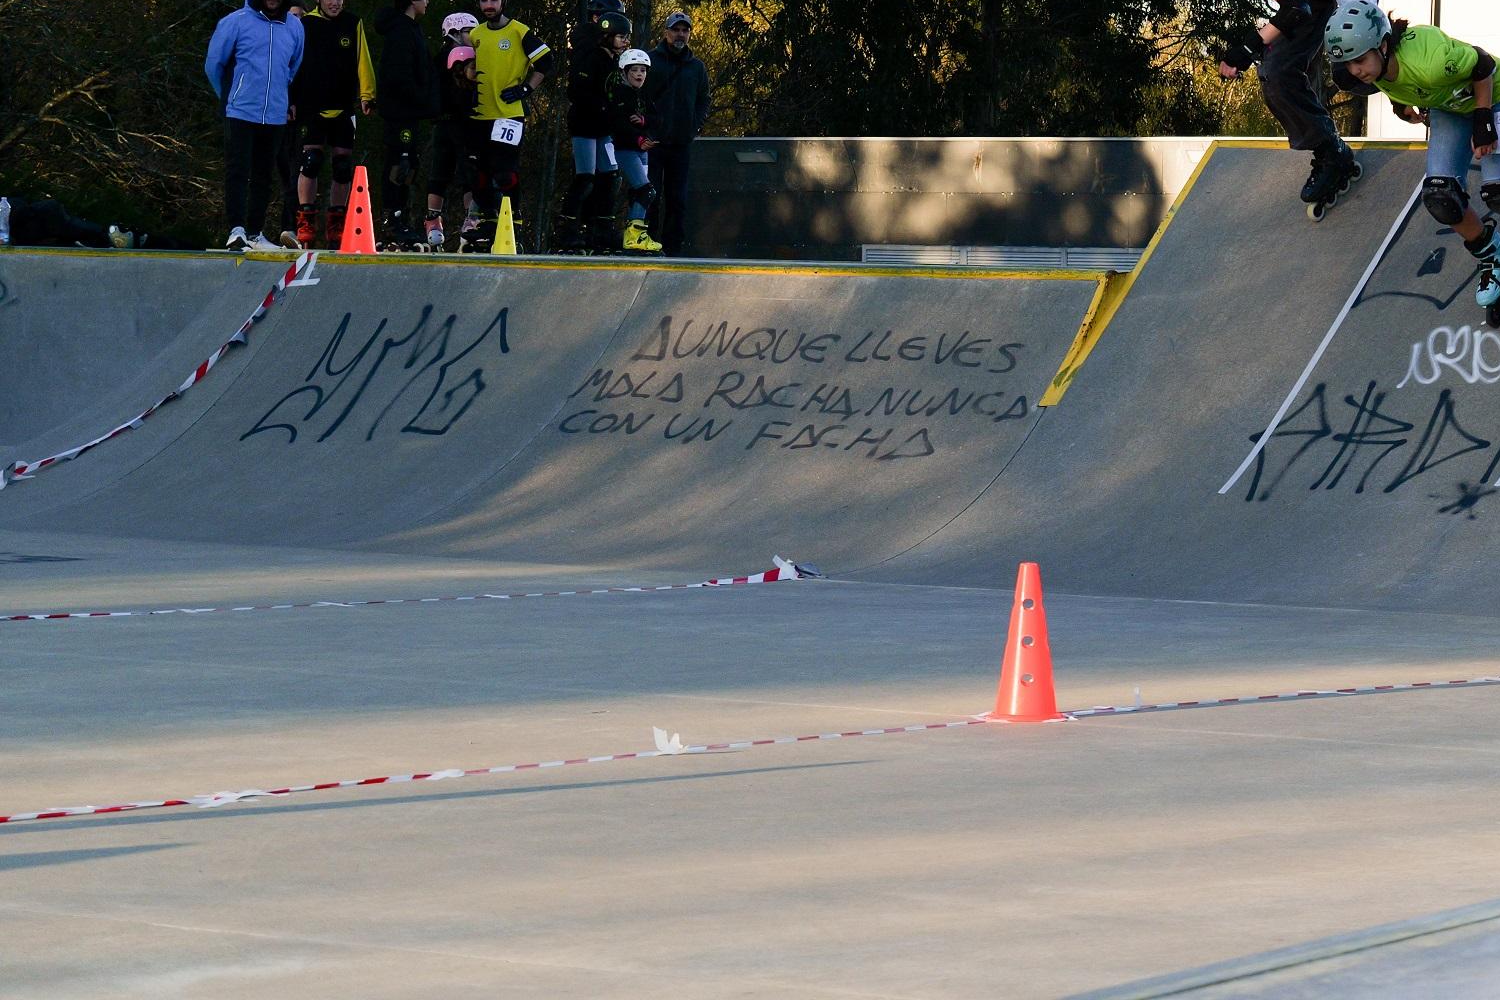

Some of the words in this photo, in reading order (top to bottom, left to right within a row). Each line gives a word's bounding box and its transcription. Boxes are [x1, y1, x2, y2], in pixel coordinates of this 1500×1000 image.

[500, 127, 515, 142] 76
[630, 315, 842, 364] AUNQUE
[844, 330, 1025, 374] LLEVES
[567, 368, 684, 403] MALA
[703, 370, 860, 422] RACHA
[864, 387, 1029, 423] NUNCA
[558, 409, 656, 436] CON
[663, 412, 734, 445] UN
[745, 420, 936, 461] FACHA
